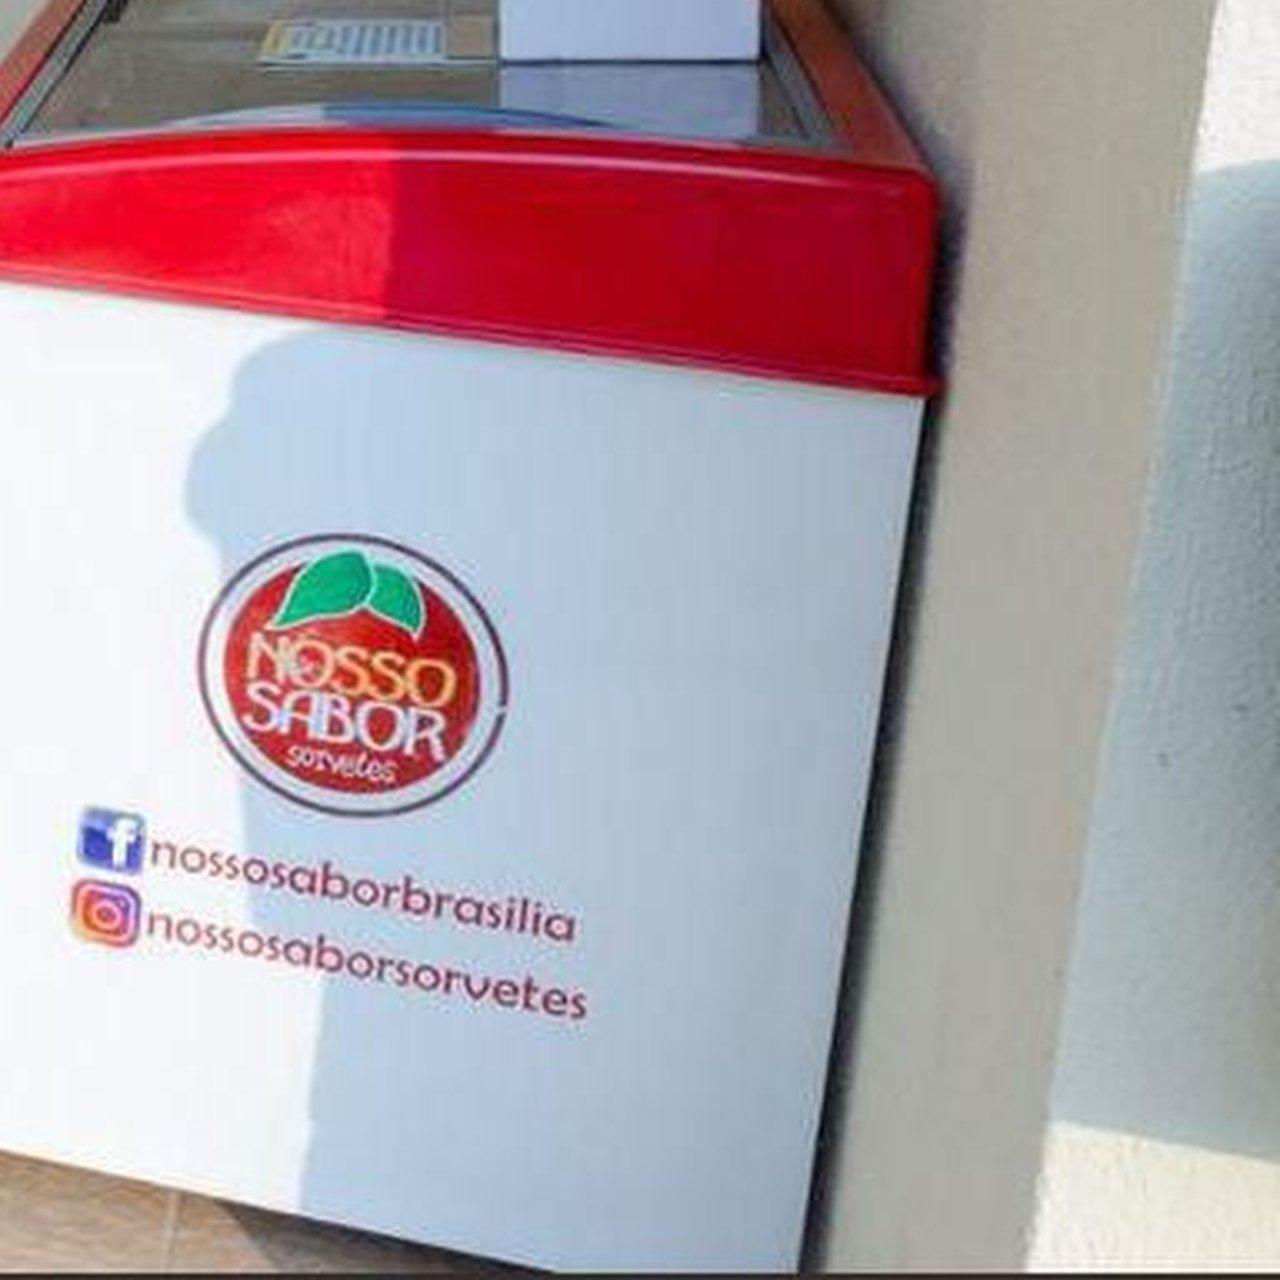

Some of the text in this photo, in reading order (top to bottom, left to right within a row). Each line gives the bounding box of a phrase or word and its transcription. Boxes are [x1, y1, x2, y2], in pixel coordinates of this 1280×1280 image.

[245, 631, 457, 710] NOSSO
[242, 681, 448, 764] SABOR
[287, 745, 398, 784] sorvetes
[150, 837, 578, 943] nossosaborbrasilia
[145, 909, 588, 1021] nossosaborsorvetes
